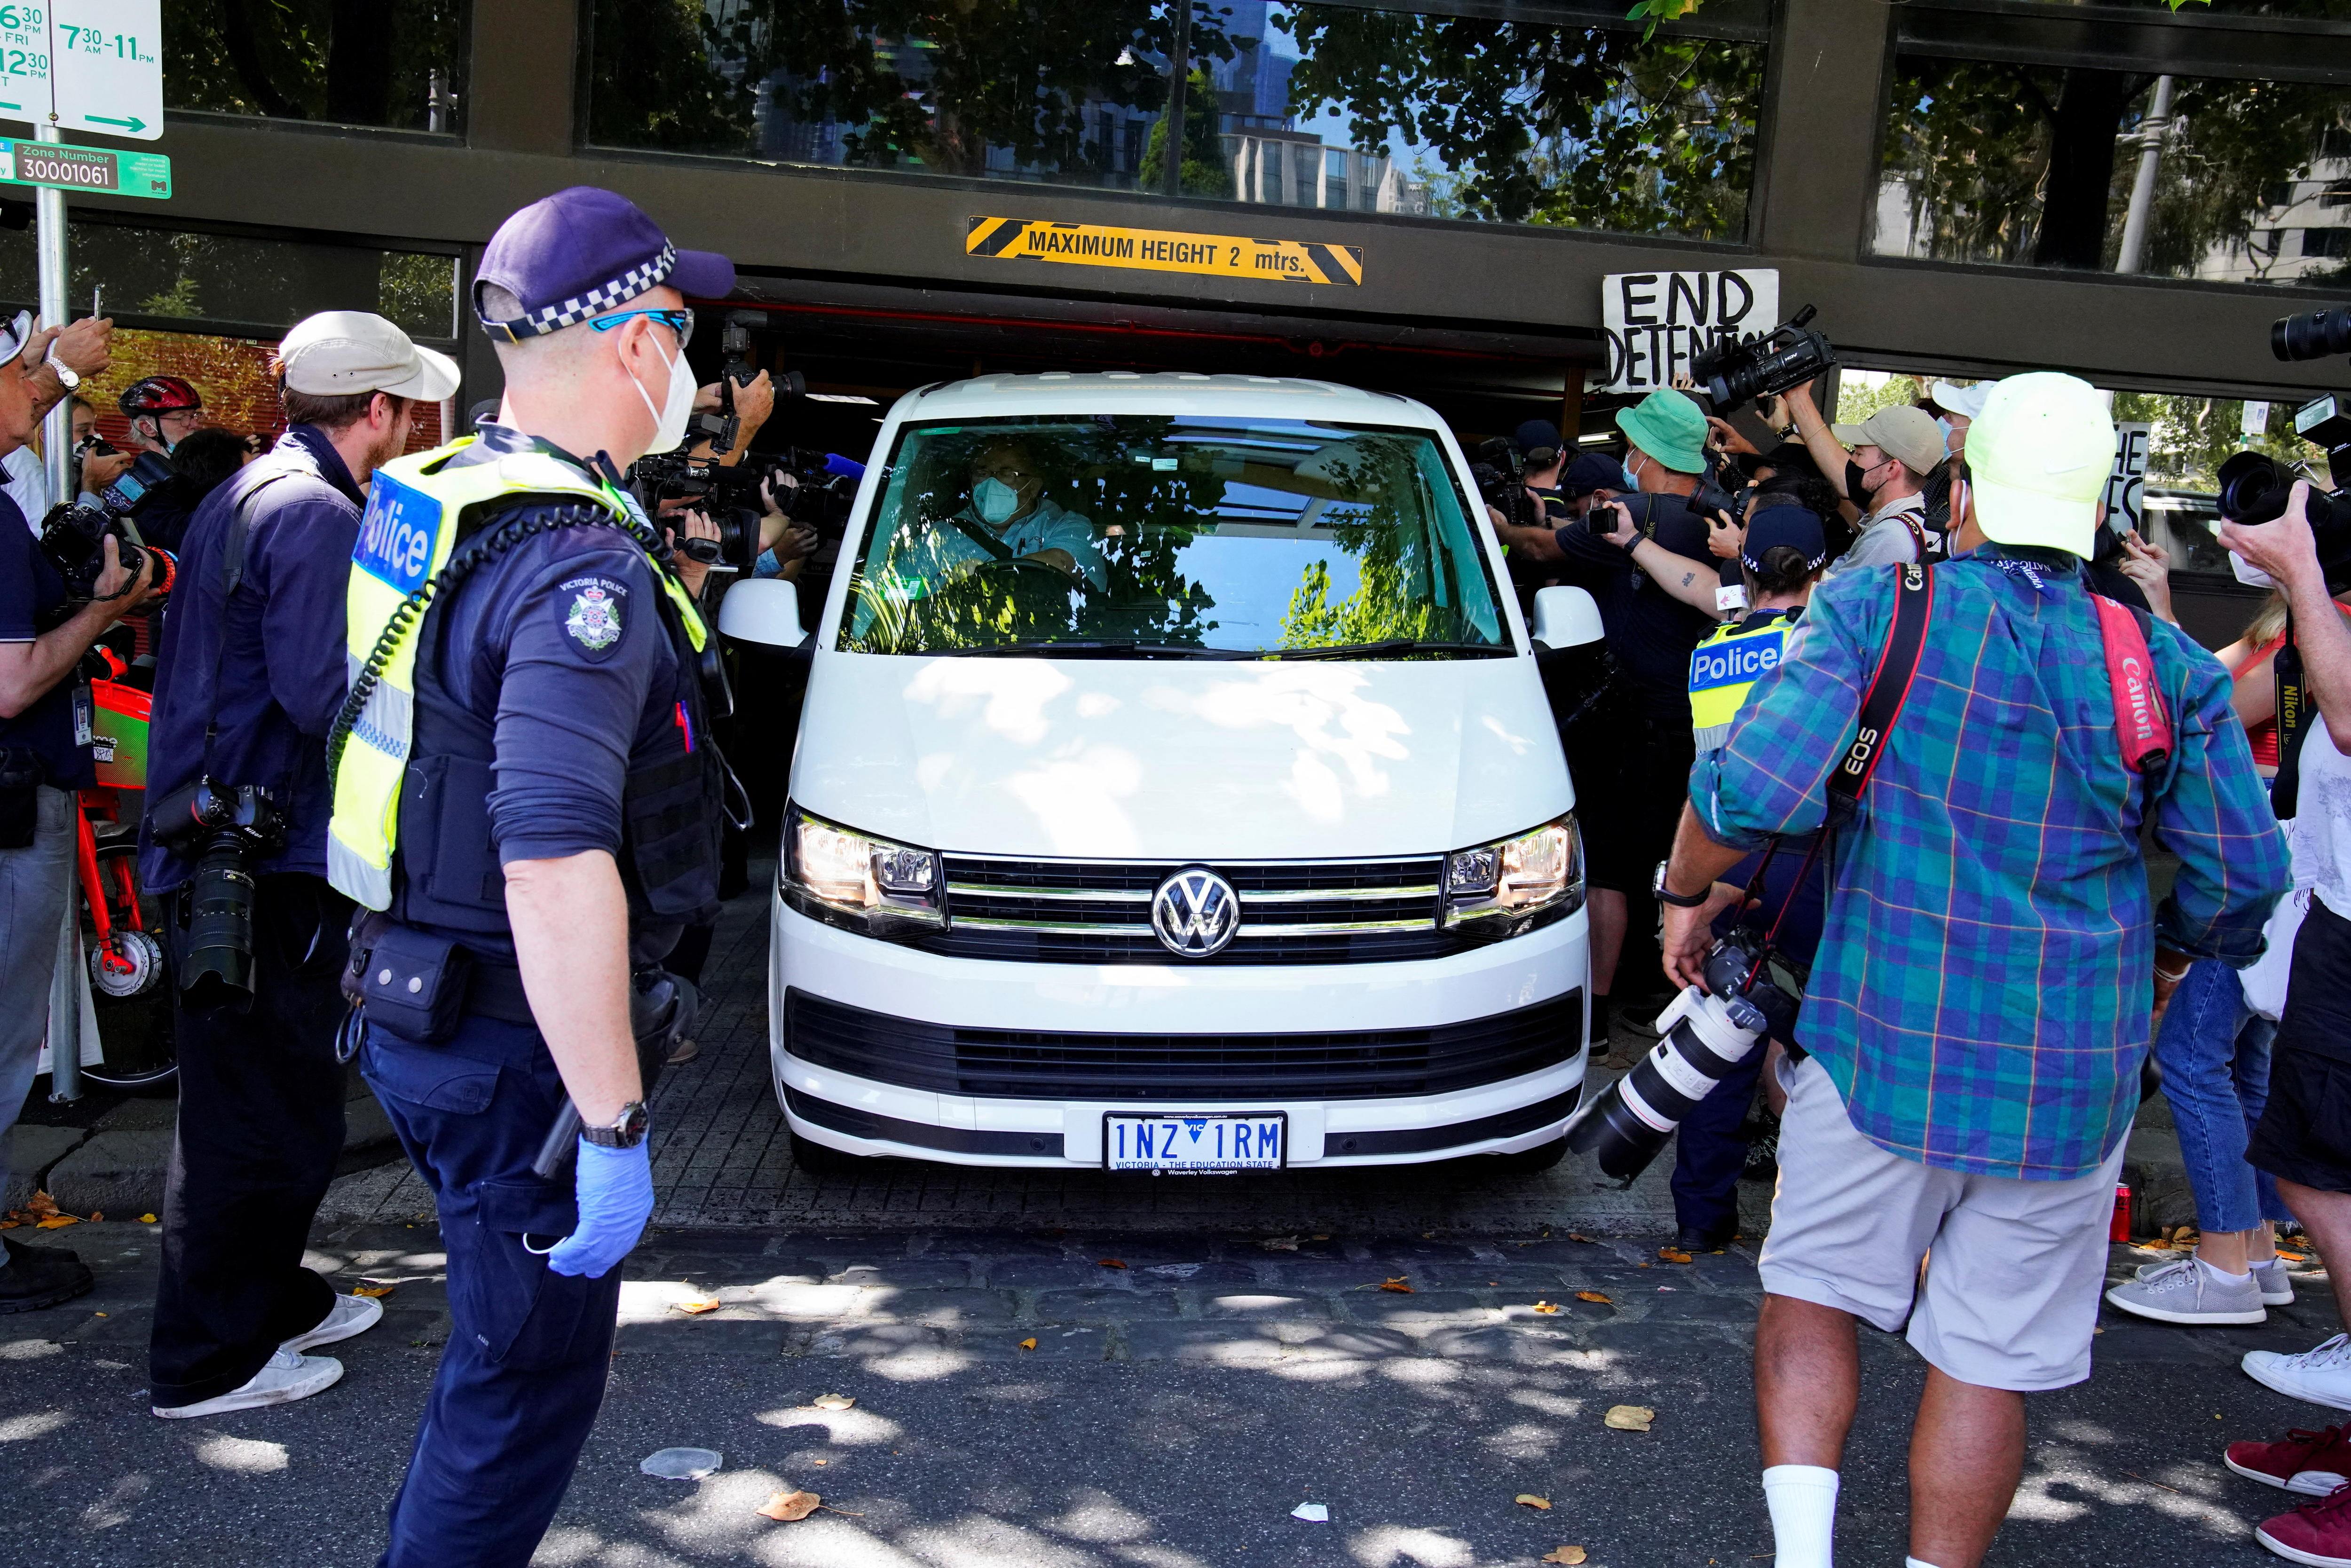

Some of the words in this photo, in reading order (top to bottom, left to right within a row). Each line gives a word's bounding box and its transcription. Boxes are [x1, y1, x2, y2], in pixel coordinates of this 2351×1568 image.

[5, 32, 29, 46] FRI
[23, 146, 55, 158] Zone
[60, 150, 109, 164] Number
[24, 159, 109, 185] 30001061
[1029, 230, 1134, 259] MAXIMUM
[1141, 239, 1218, 266] HEIGHT
[1230, 246, 1239, 267] 2
[1255, 251, 1305, 272] mtrs.
[1621, 270, 1754, 326] END
[1785, 352, 1798, 361] HDV
[2334, 442, 2347, 451] Nikon
[360, 489, 428, 577] Police
[559, 577, 599, 591] VICTORIA
[600, 579, 628, 597] POLICE
[1694, 647, 1778, 684] Police
[2122, 657, 2153, 740] Canon
[2284, 685, 2298, 728] Nikon
[1844, 726, 1878, 775] EOS
[244, 827, 263, 838] Nikon
[1116, 1124, 1178, 1158] 1NZ
[1215, 1123, 1278, 1158] 1RM
